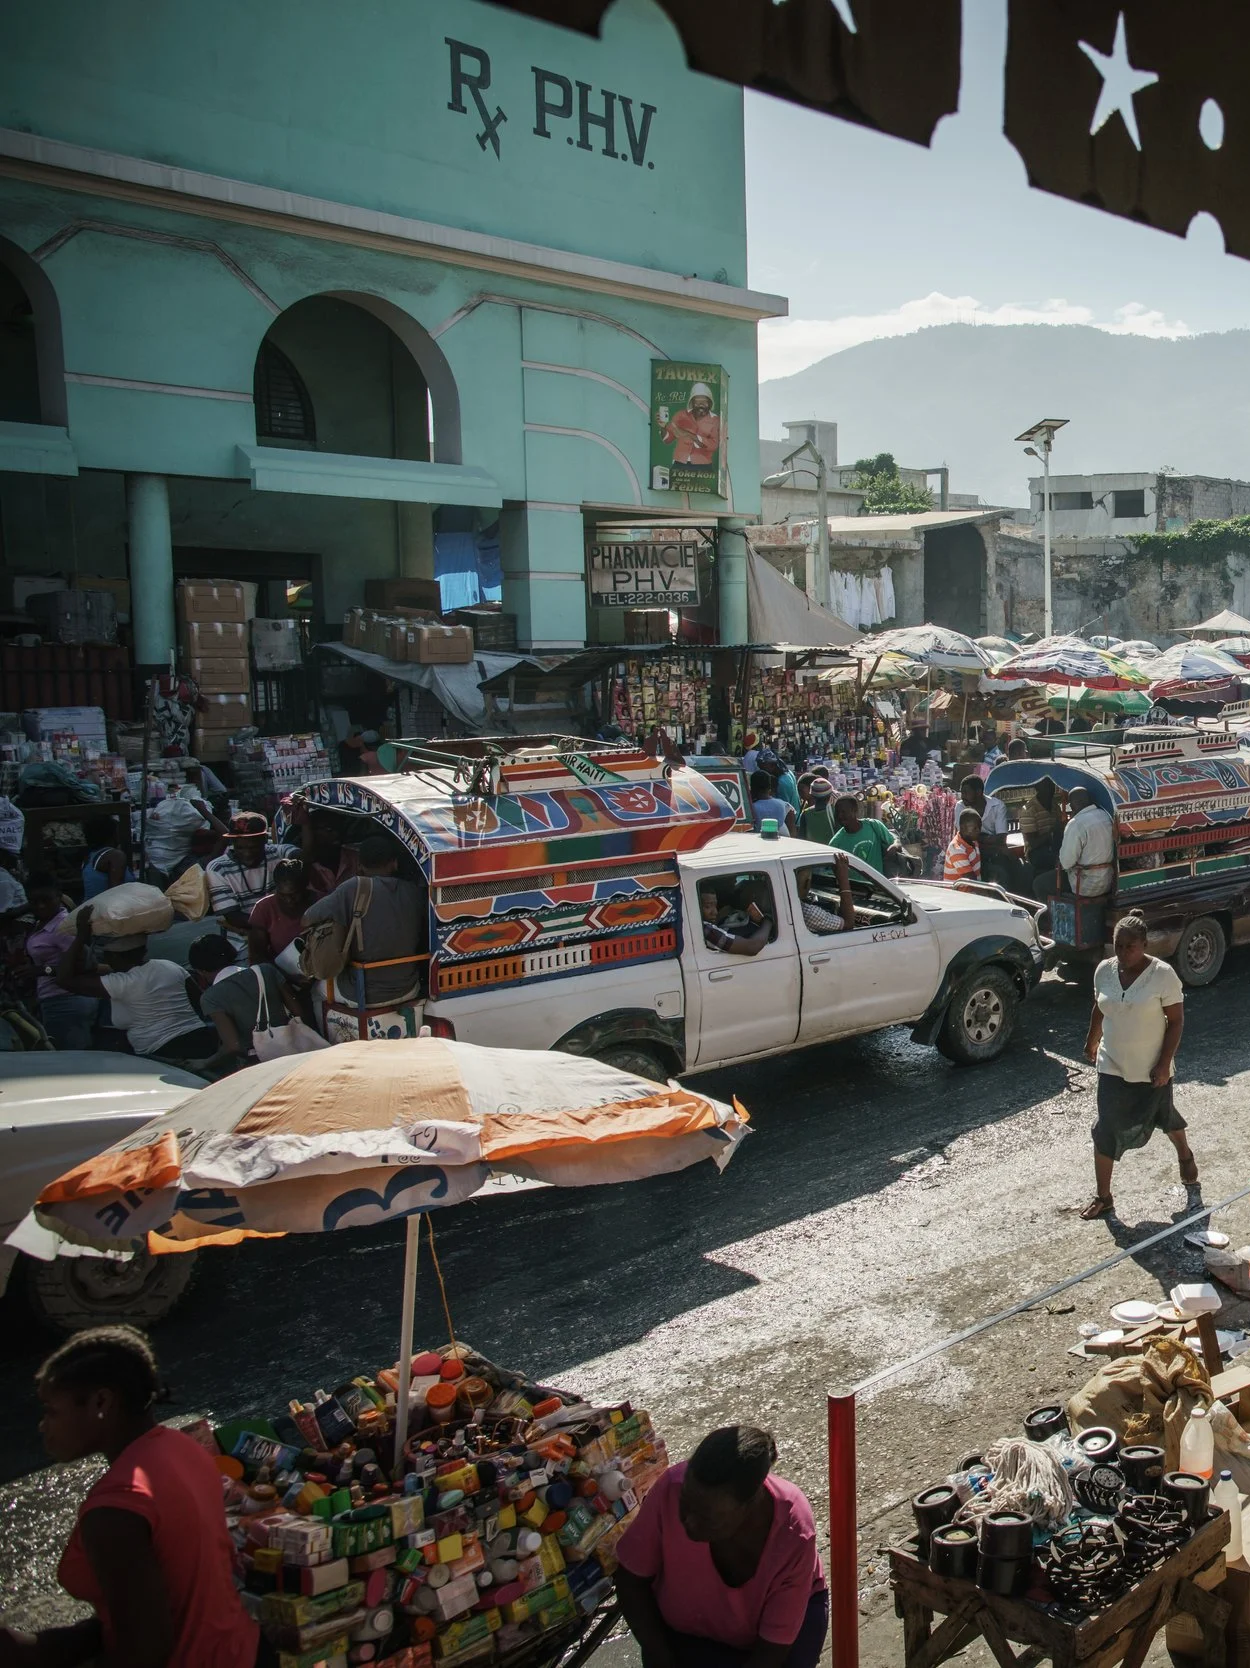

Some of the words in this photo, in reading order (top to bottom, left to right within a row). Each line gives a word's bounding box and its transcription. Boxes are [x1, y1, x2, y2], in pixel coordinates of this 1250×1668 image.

[530, 65, 657, 171] P.H.V.
[591, 545, 694, 569] PHARMACIE
[612, 570, 675, 591] PHV
[560, 754, 578, 767] AIR
[577, 761, 606, 782] HAITI
